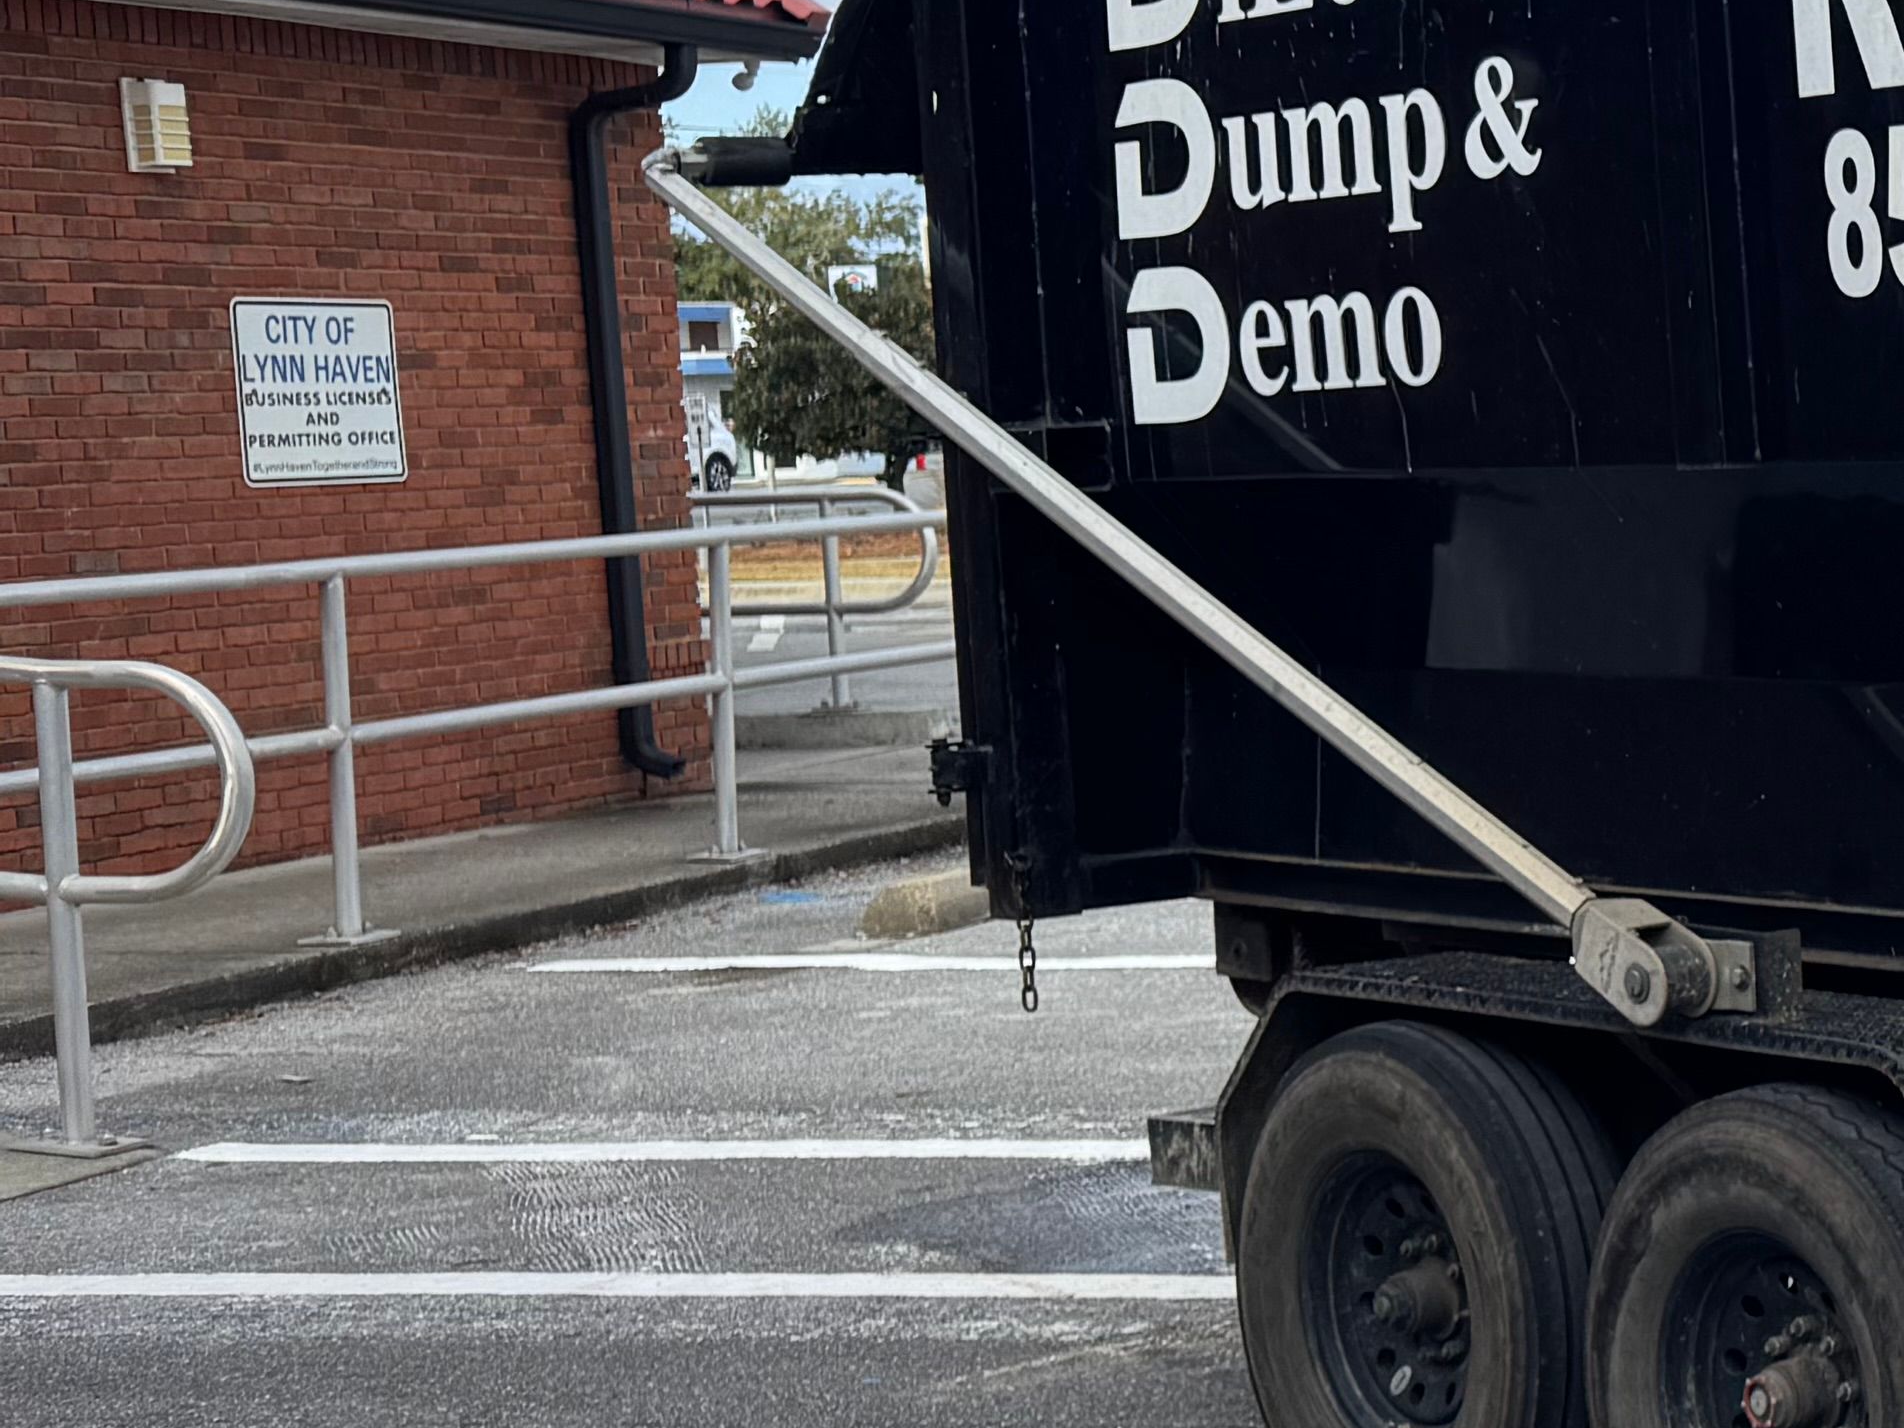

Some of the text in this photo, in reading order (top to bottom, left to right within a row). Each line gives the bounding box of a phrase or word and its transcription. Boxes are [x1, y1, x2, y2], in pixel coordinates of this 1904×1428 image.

[1114, 55, 1543, 240] Dump &
[265, 314, 355, 346] CITY OF
[1126, 265, 1443, 425] Demo
[242, 353, 391, 384] LYNN HAVEN
[245, 389, 392, 407] BUSINESS LICENSES
[306, 412, 340, 426] AND
[249, 430, 396, 448] PERMITTING OFFICE
